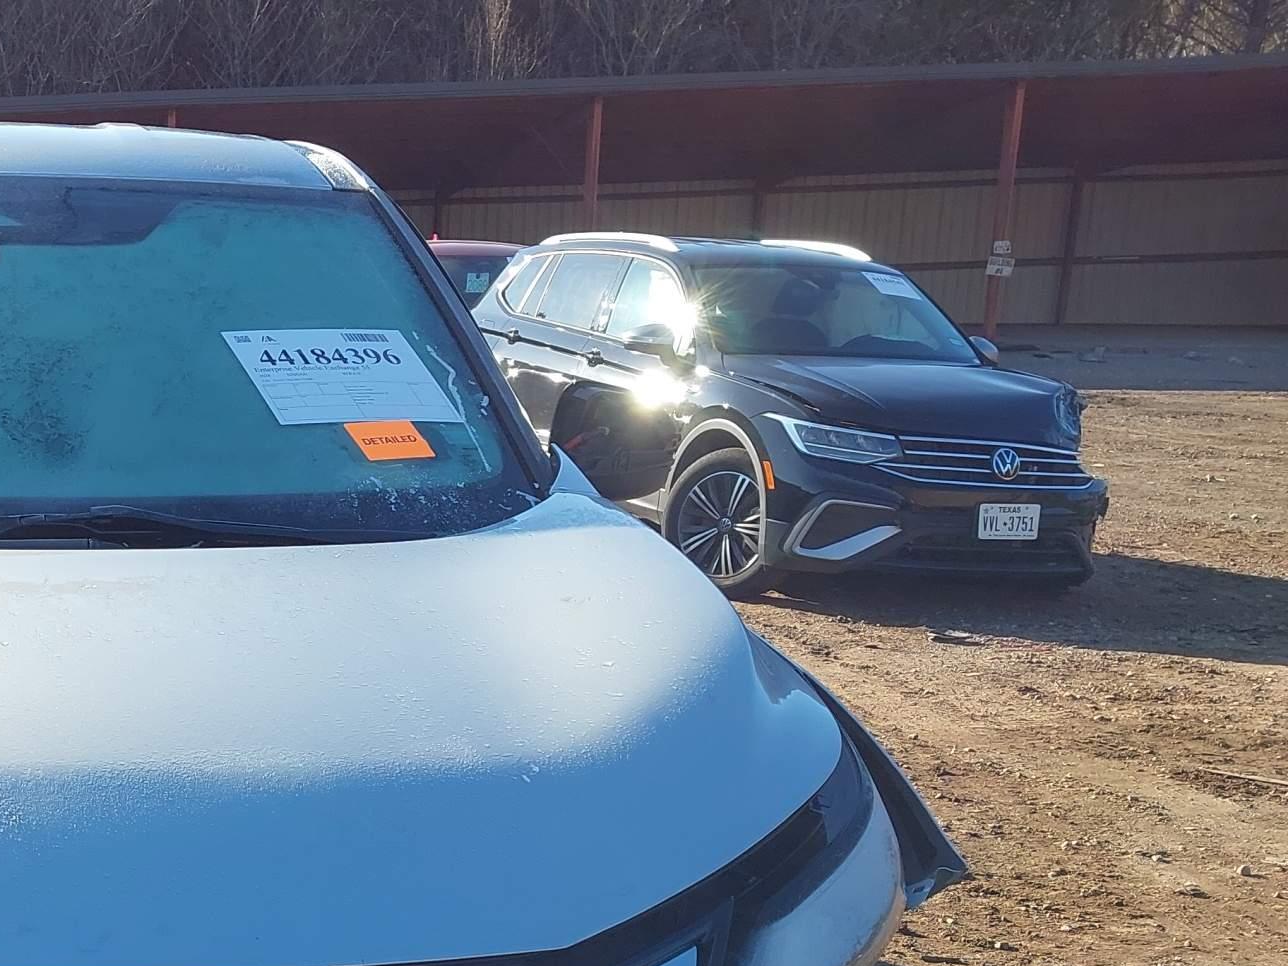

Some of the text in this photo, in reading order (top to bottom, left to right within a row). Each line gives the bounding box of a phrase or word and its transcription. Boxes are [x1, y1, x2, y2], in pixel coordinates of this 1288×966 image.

[259, 347, 402, 366] 44184396
[361, 434, 417, 446] DETAILED
[983, 515, 1034, 532] VVL 3751
